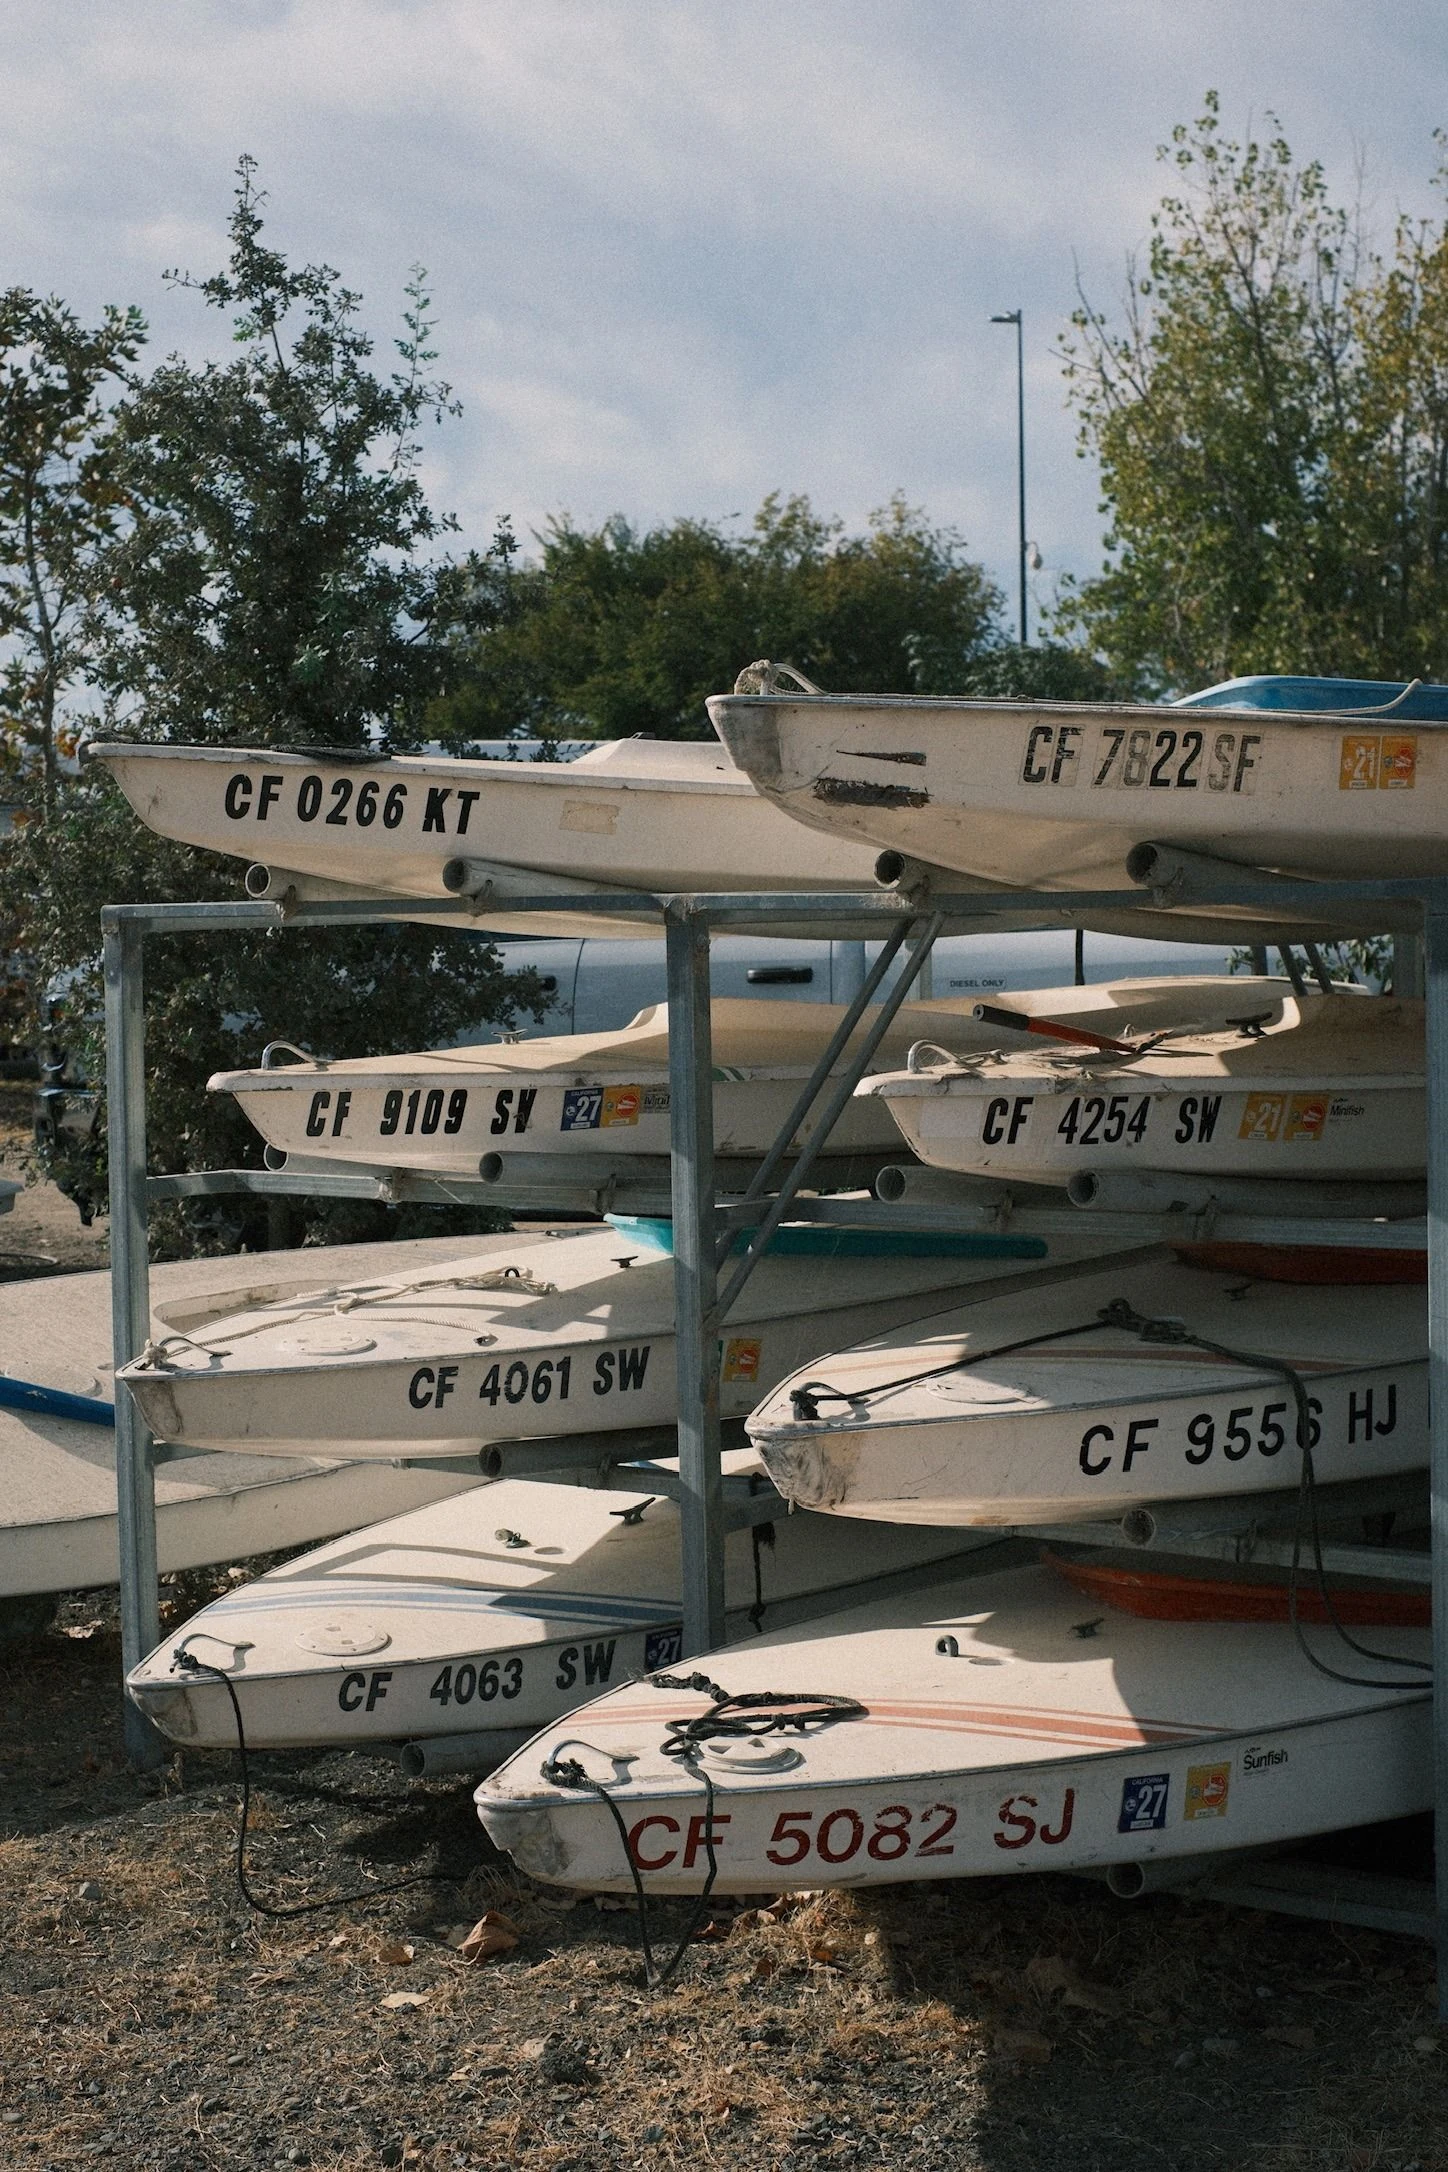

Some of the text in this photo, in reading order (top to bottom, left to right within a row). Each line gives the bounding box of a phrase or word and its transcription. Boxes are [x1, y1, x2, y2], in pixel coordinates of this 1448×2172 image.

[1022, 726, 1261, 792] CF 7822 SF
[224, 774, 480, 835] CF 0266 KT
[982, 979, 1004, 987] ONLY
[306, 1091, 352, 1137] CF
[380, 1089, 468, 1135] 9109
[575, 1095, 601, 1121] 27
[982, 1096, 1222, 1145] CF 4254 SW
[1254, 1102, 1281, 1132] 21
[1330, 1104, 1365, 1116] Minifish
[408, 1346, 651, 1408] CF 4061 SW
[1079, 1384, 1397, 1476] CF 9556 HJ
[657, 1635, 680, 1665] 27
[338, 1639, 617, 1712] CF 4063 SW
[1243, 1749, 1289, 1770] Sunfish
[1132, 1777, 1163, 1785] CALIFORNIA
[1136, 1784, 1167, 1819] 27
[628, 1788, 1075, 1870] CF 5082 SJ
